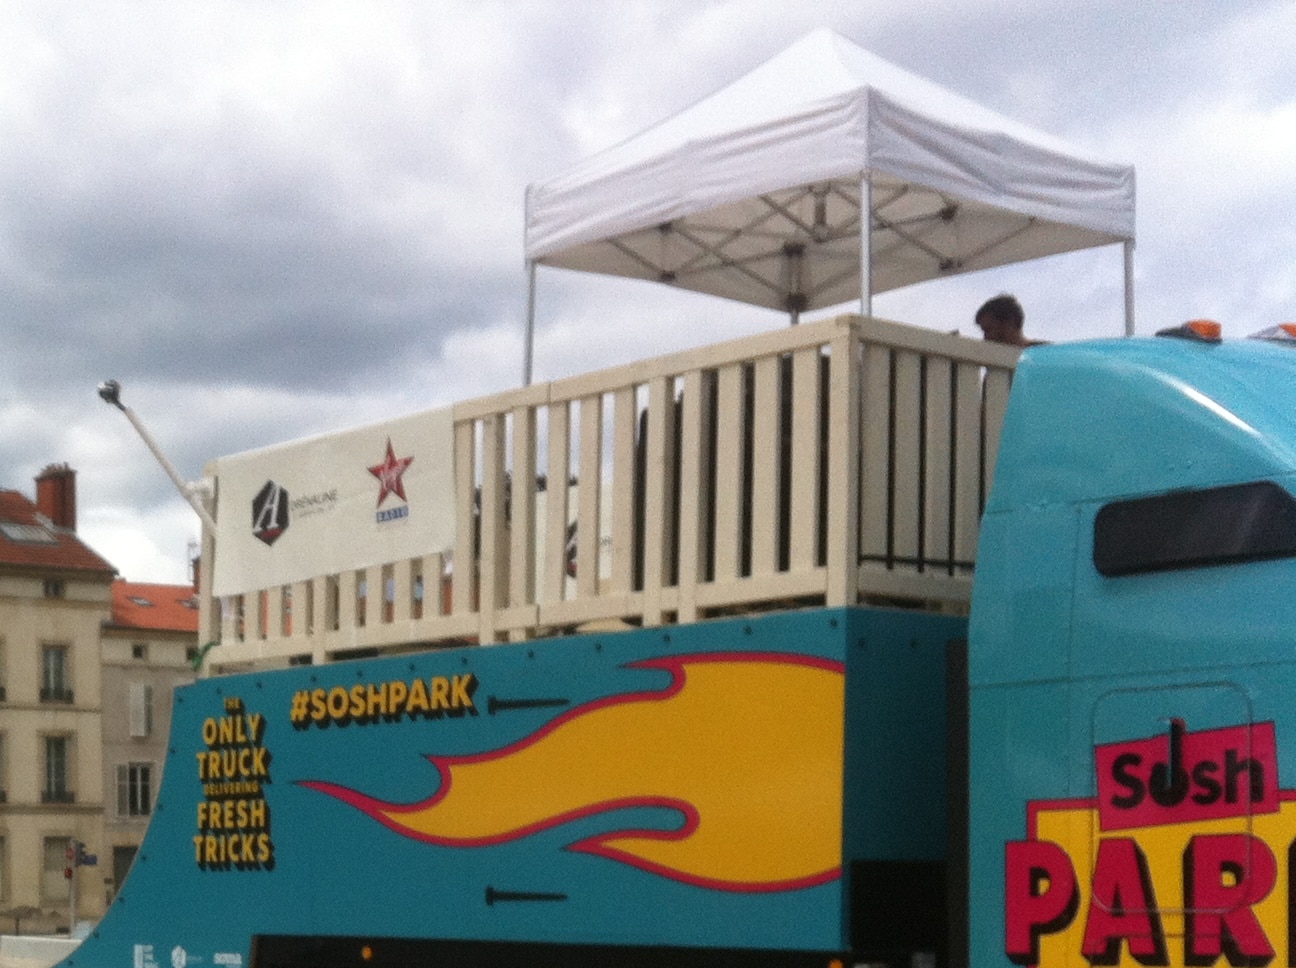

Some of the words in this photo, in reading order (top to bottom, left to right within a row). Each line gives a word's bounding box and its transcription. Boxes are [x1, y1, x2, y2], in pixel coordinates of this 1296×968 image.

[290, 674, 476, 726] #SOSHPARK
[202, 713, 264, 746] ONLY
[196, 747, 268, 780] TRUCK
[1111, 717, 1266, 810] Sosh
[204, 781, 260, 796] DELIVERING
[197, 799, 267, 830] FRESH
[193, 833, 271, 864] TRICKS
[1005, 833, 1296, 968] PAR
